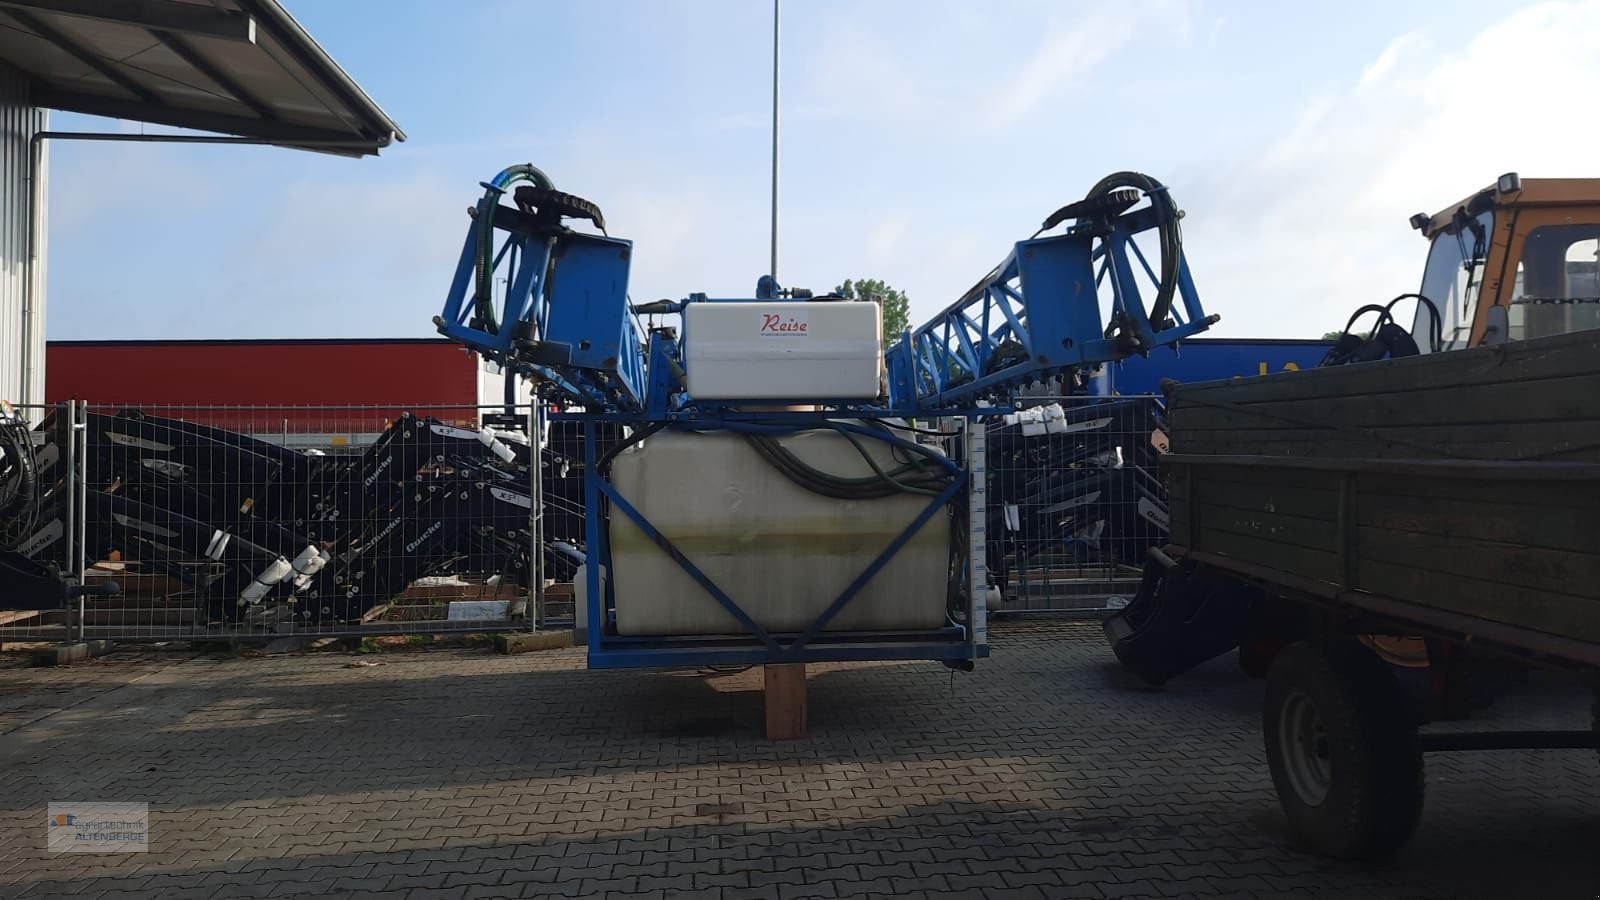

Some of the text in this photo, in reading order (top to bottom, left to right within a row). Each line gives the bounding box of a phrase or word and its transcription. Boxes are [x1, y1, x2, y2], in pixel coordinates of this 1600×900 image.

[761, 314, 808, 331] Reise
[365, 455, 393, 486] Quicke
[406, 521, 441, 552] Quicke
